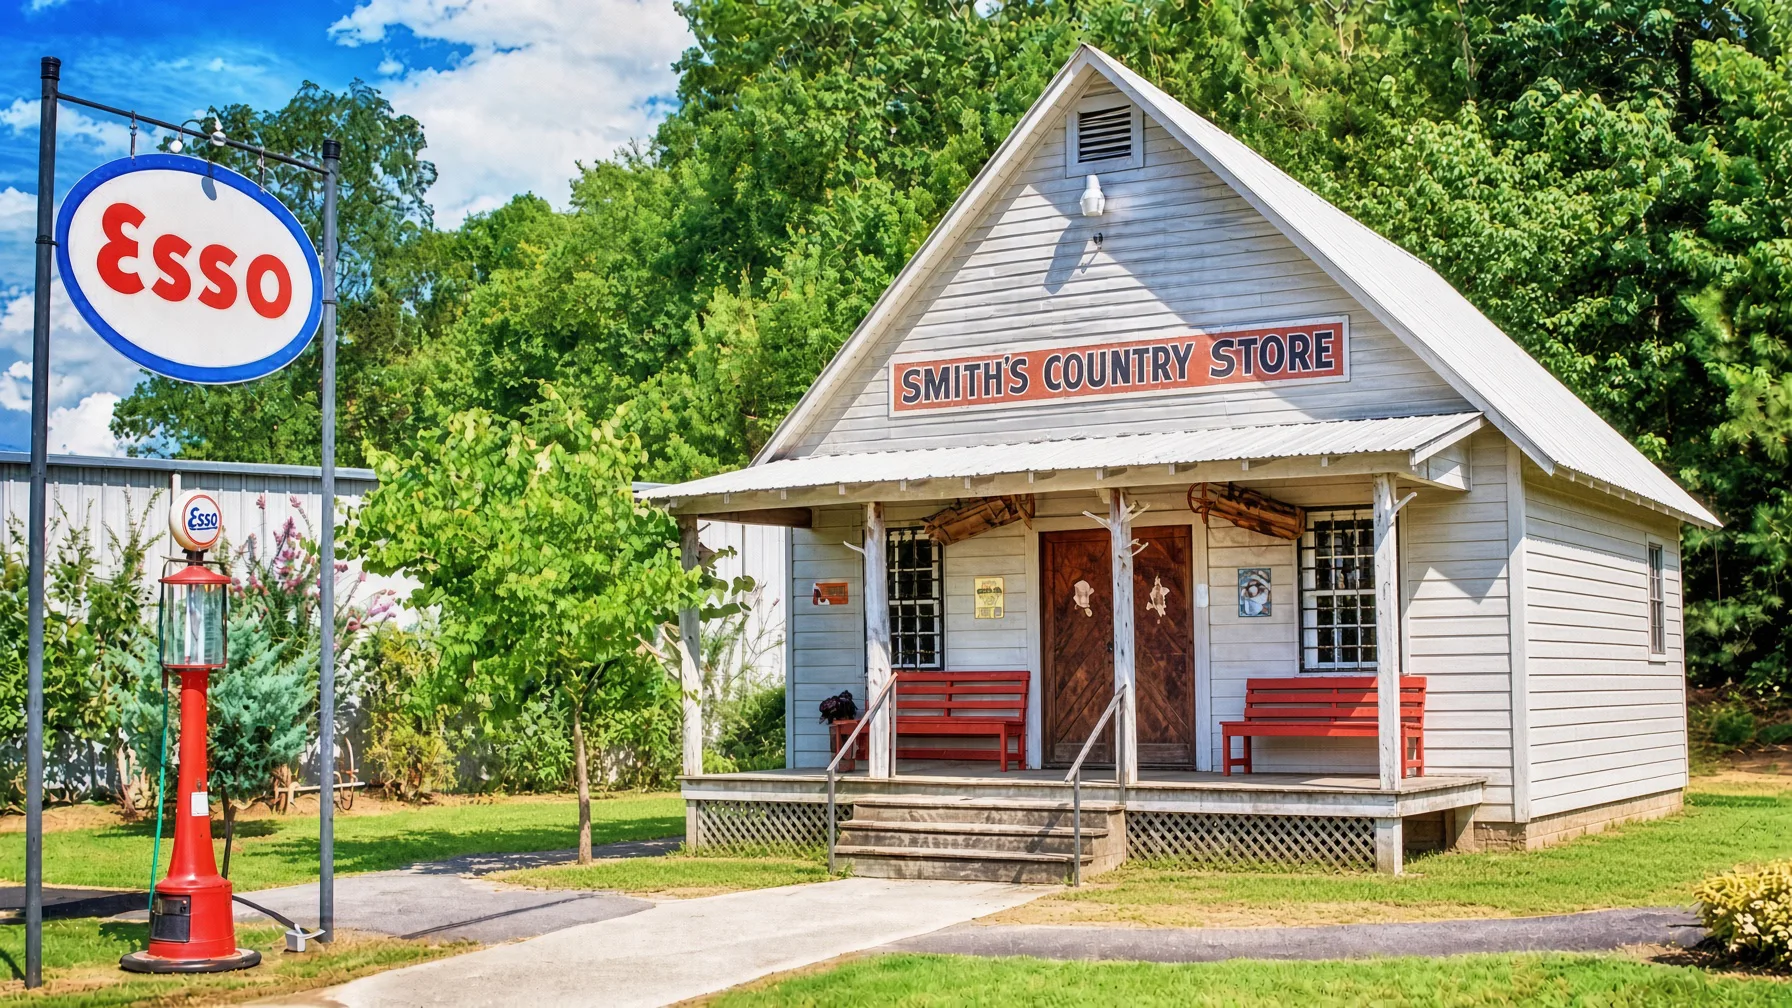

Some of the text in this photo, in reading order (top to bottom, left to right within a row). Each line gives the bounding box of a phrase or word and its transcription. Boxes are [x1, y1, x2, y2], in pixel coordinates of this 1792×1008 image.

[901, 331, 1335, 404] SMITH'S COUNTRY STORE
